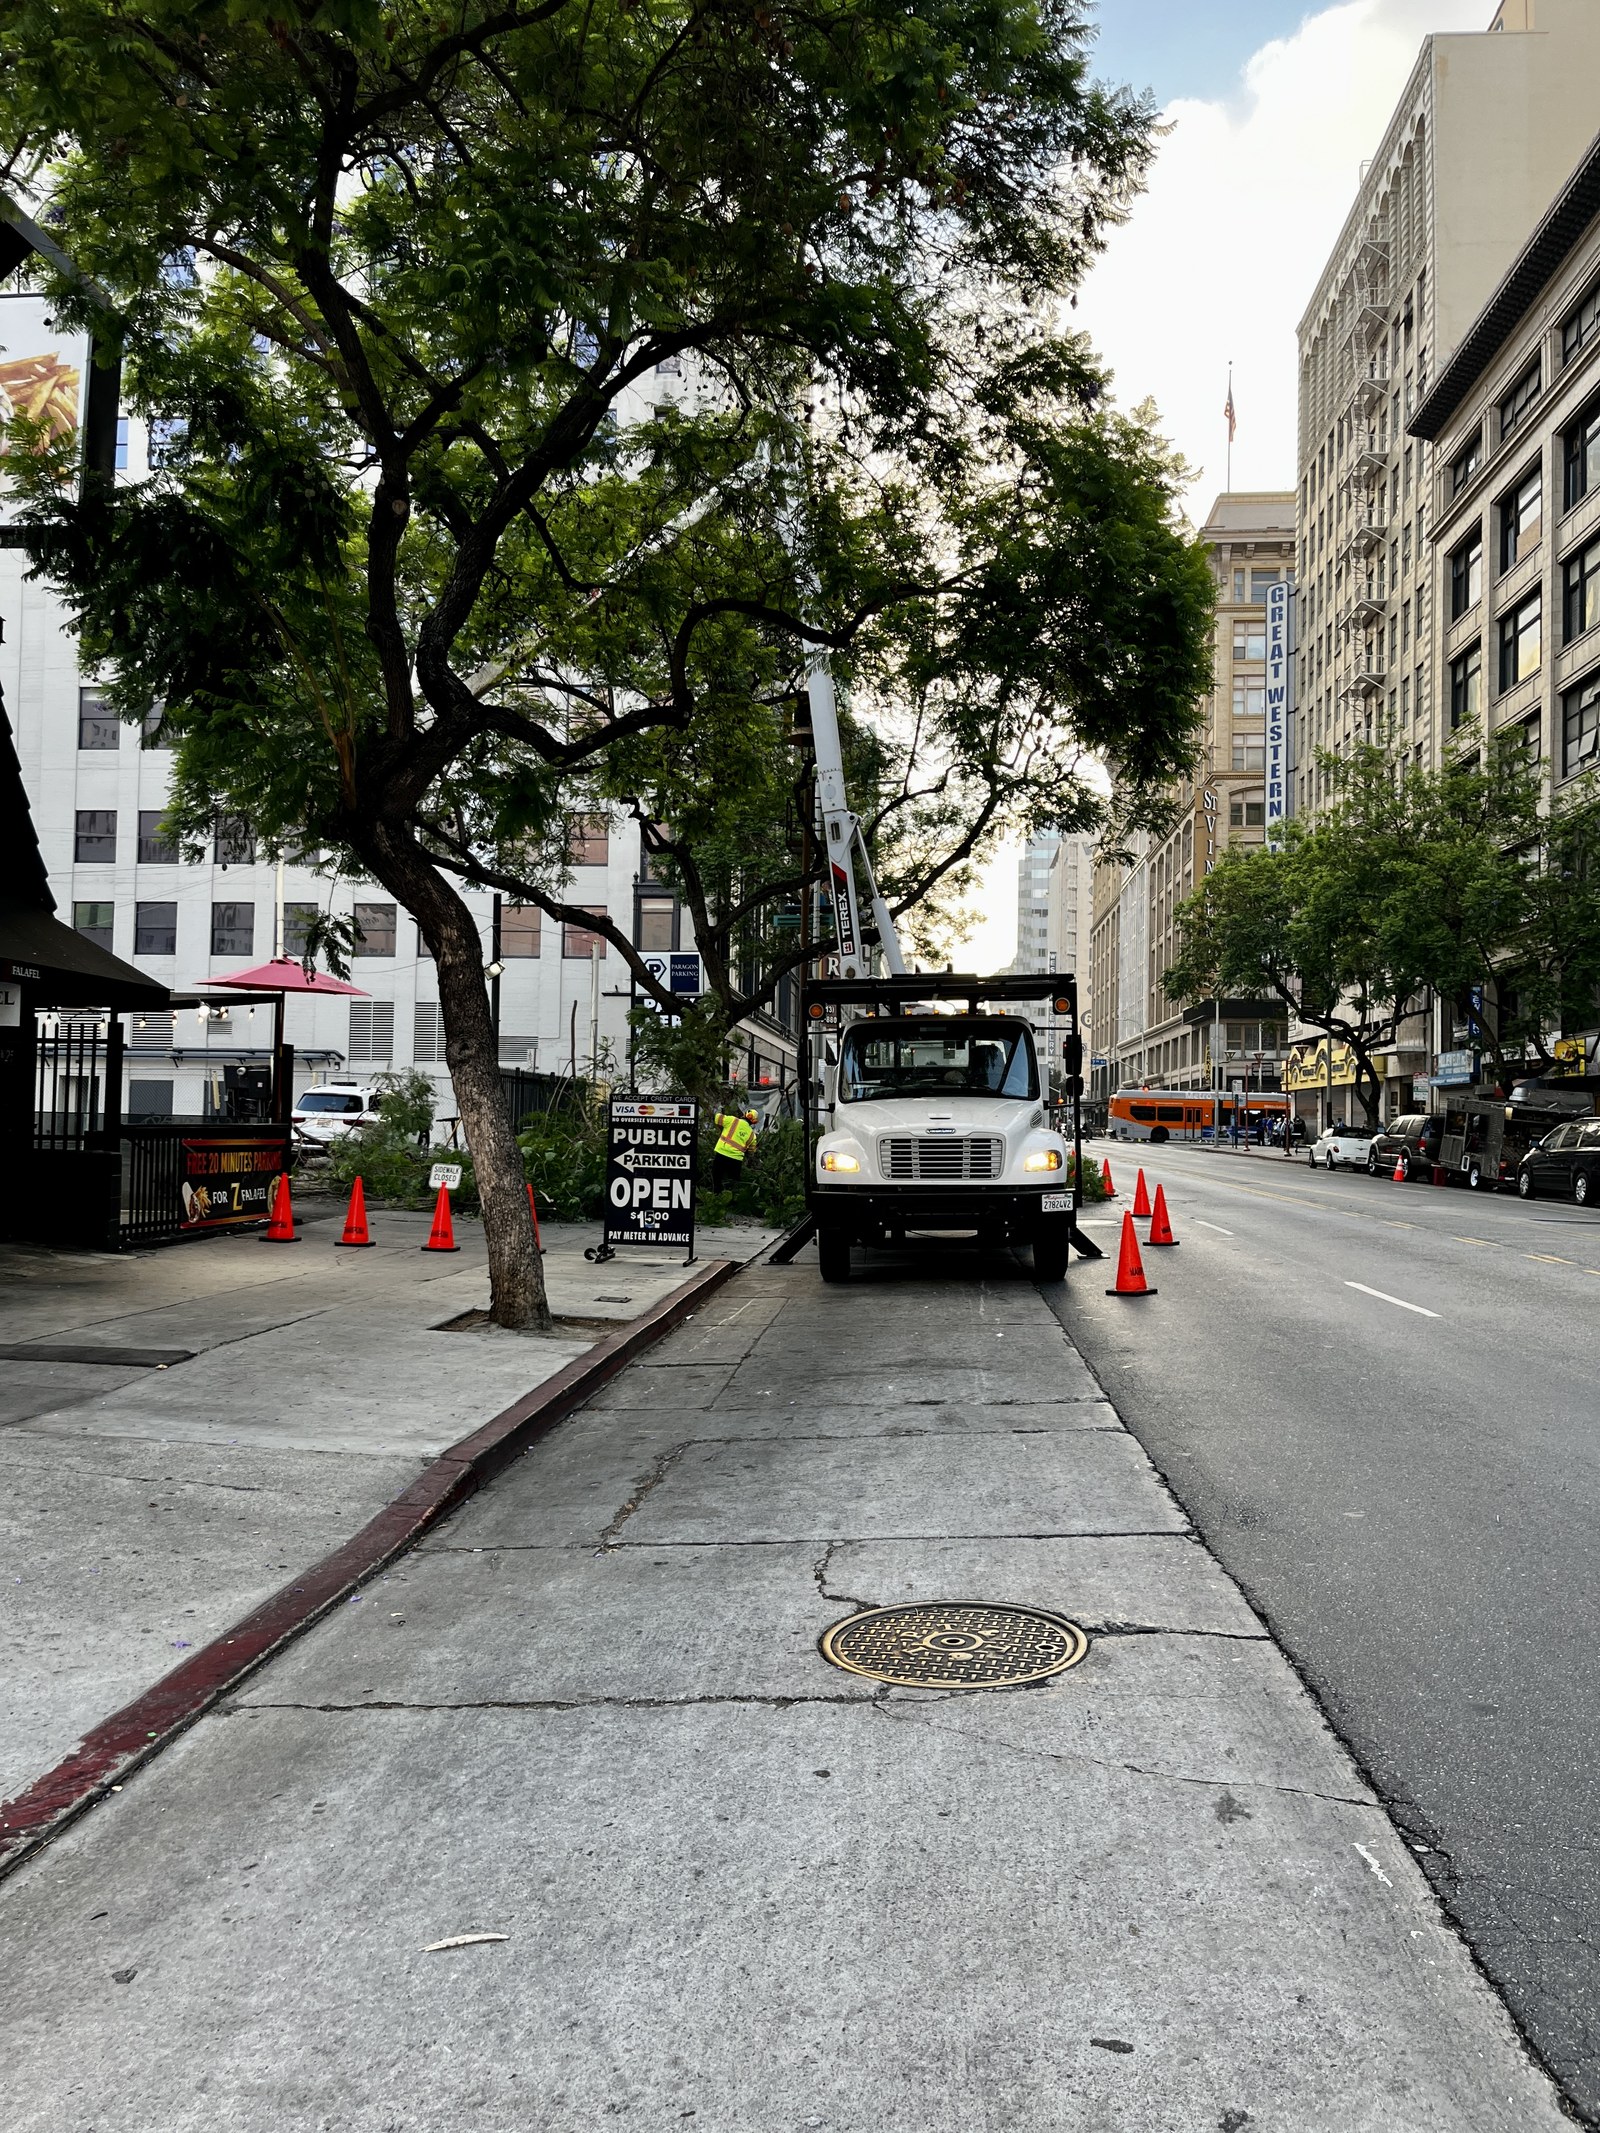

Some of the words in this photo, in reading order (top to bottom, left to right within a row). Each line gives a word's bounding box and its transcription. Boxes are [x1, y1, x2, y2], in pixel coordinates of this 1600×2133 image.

[1270, 586, 1286, 679] GREAT
[1268, 686, 1285, 818] WESTERN
[837, 892, 851, 939] TEREX
[12, 965, 41, 979] FALAFEL
[1185, 1092, 1212, 1100] Metro
[615, 1106, 635, 1114] VISA
[613, 1128, 692, 1147] PUBLIC
[186, 1152, 207, 1175] FREE
[208, 1152, 219, 1174] 20
[220, 1151, 253, 1173] MINUTES
[623, 1154, 687, 1168] PARKING
[433, 1173, 457, 1182] CLOSED
[434, 1165, 460, 1175] SIDEWALK
[212, 1191, 228, 1204] FOR
[231, 1182, 243, 1211] Z
[241, 1187, 267, 1201] FALAFEL
[610, 1176, 691, 1209] OPEN
[608, 1231, 621, 1240] PAY
[623, 1231, 647, 1241] METER
[648, 1232, 657, 1241] IN
[658, 1232, 690, 1242] ADVANCE
